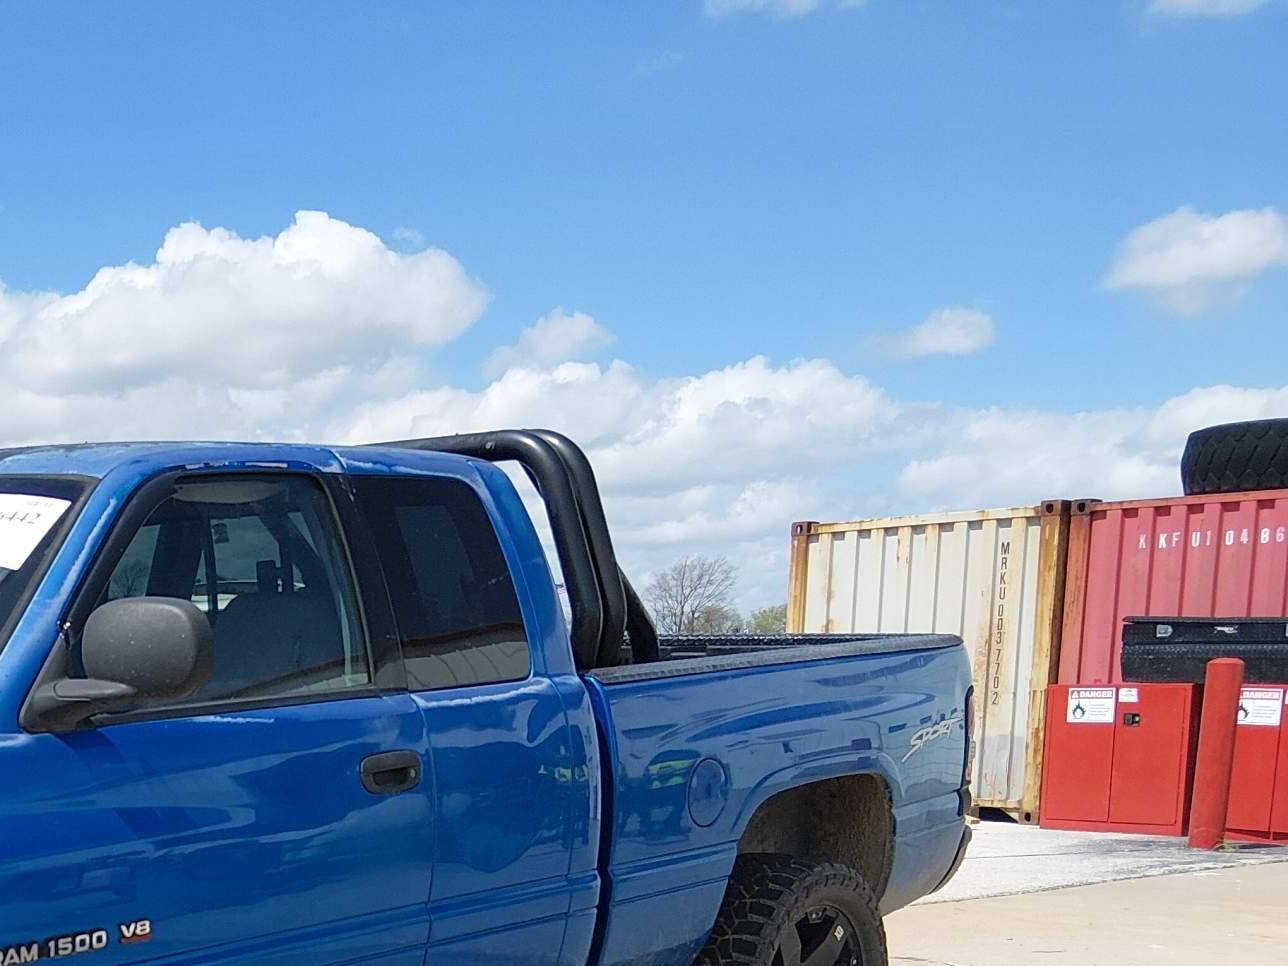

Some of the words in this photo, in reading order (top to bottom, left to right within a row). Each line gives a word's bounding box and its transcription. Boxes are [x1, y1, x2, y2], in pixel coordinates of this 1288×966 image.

[1079, 690, 1113, 698] DANGER
[47, 930, 107, 958] 1500
[120, 919, 151, 938] V8
